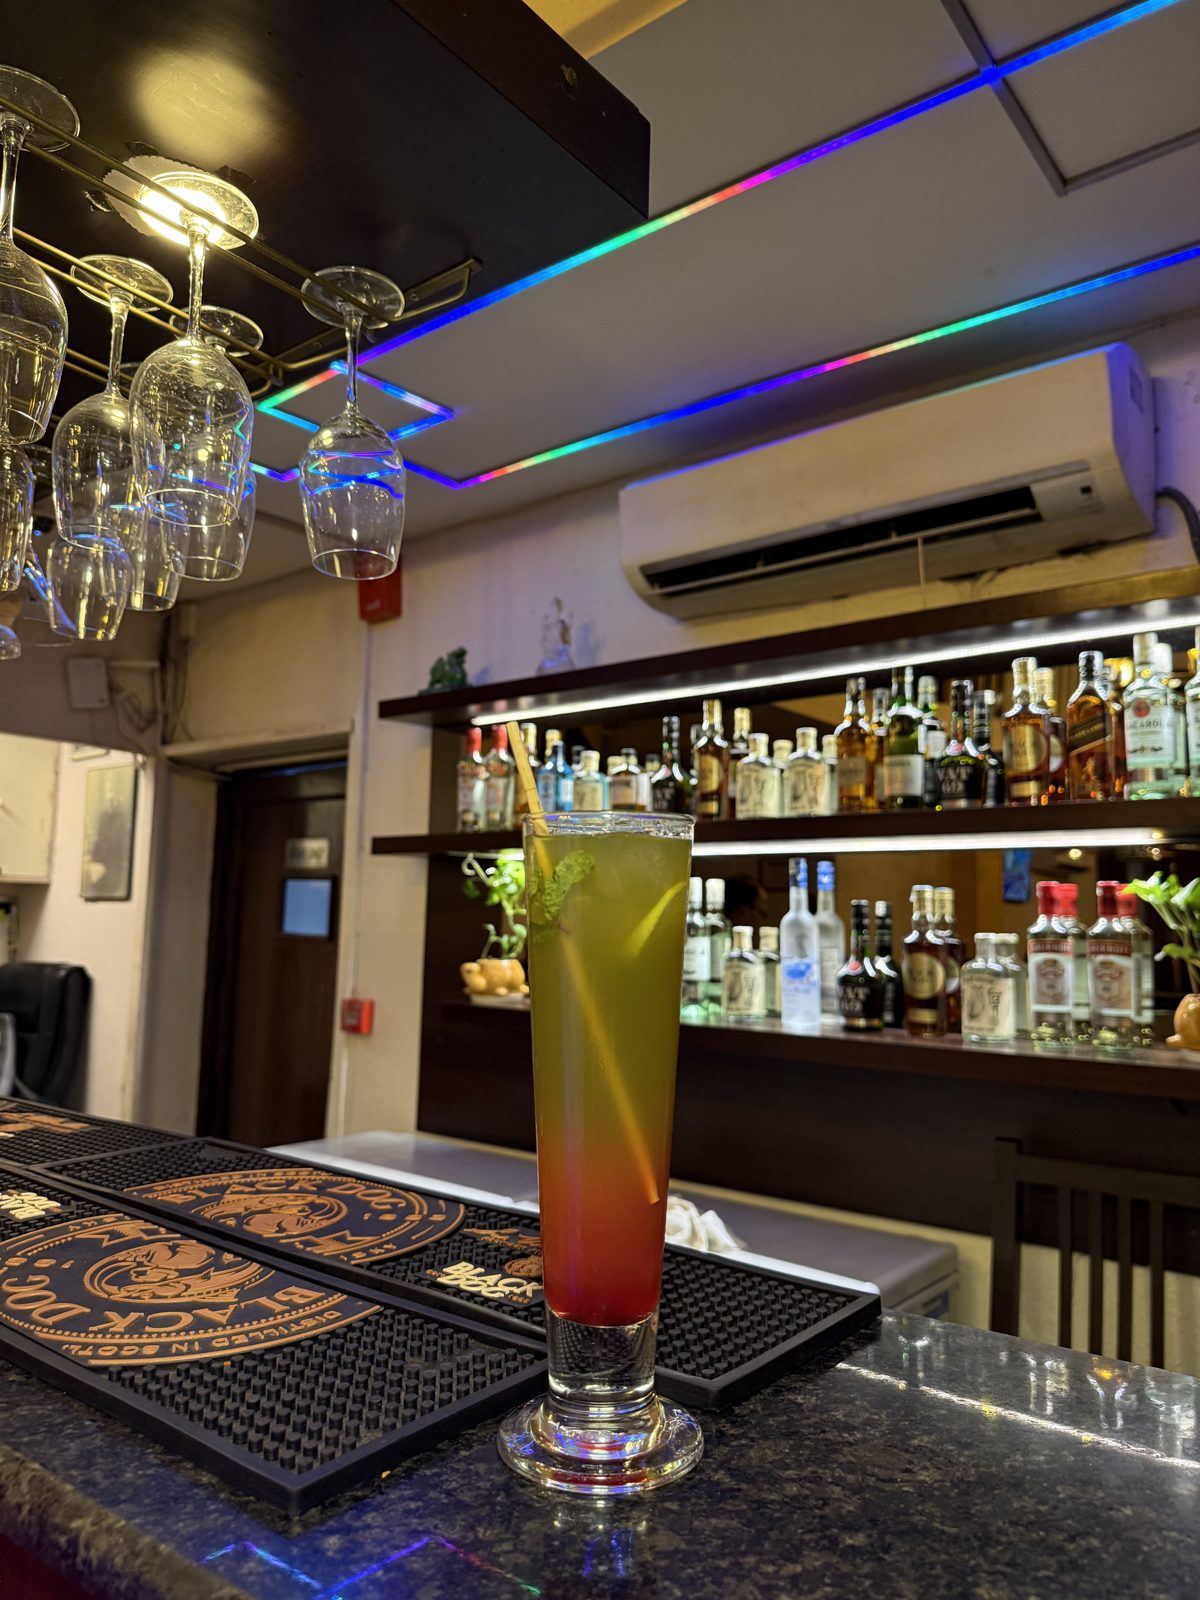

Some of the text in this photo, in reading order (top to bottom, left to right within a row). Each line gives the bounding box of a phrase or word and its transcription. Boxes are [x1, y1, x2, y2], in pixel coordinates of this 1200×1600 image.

[157, 1179, 407, 1211] BLACK DOG
[436, 1274, 510, 1298] DOG
[443, 1261, 544, 1298] BLACK
[1, 1274, 327, 1333] BLACK DOG
[210, 1309, 343, 1348] DISTILLED
[171, 1340, 200, 1354] IN
